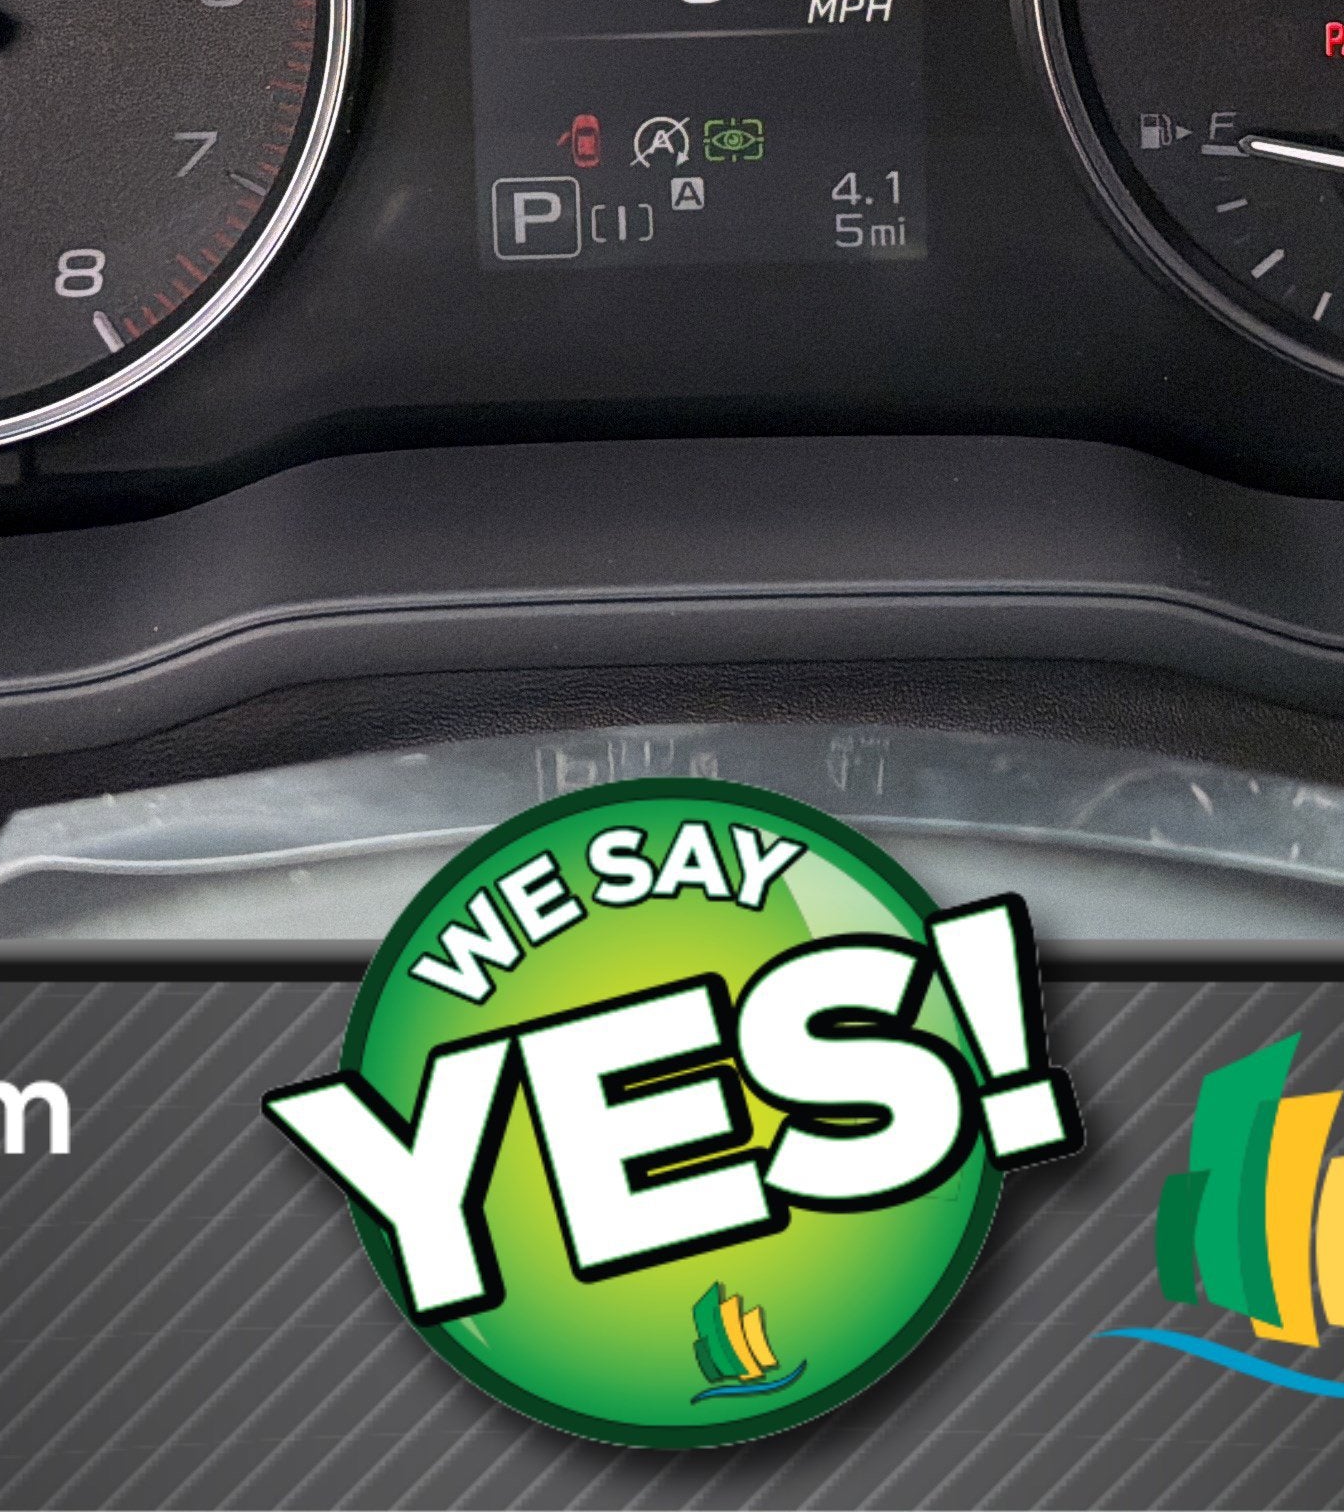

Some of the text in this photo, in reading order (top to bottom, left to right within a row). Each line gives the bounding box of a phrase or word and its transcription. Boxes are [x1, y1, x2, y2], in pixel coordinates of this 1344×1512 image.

[1209, 111, 1237, 140] F
[175, 131, 218, 177] 7
[831, 170, 900, 205] 4.1
[513, 191, 562, 244] P
[55, 248, 106, 298] 8
